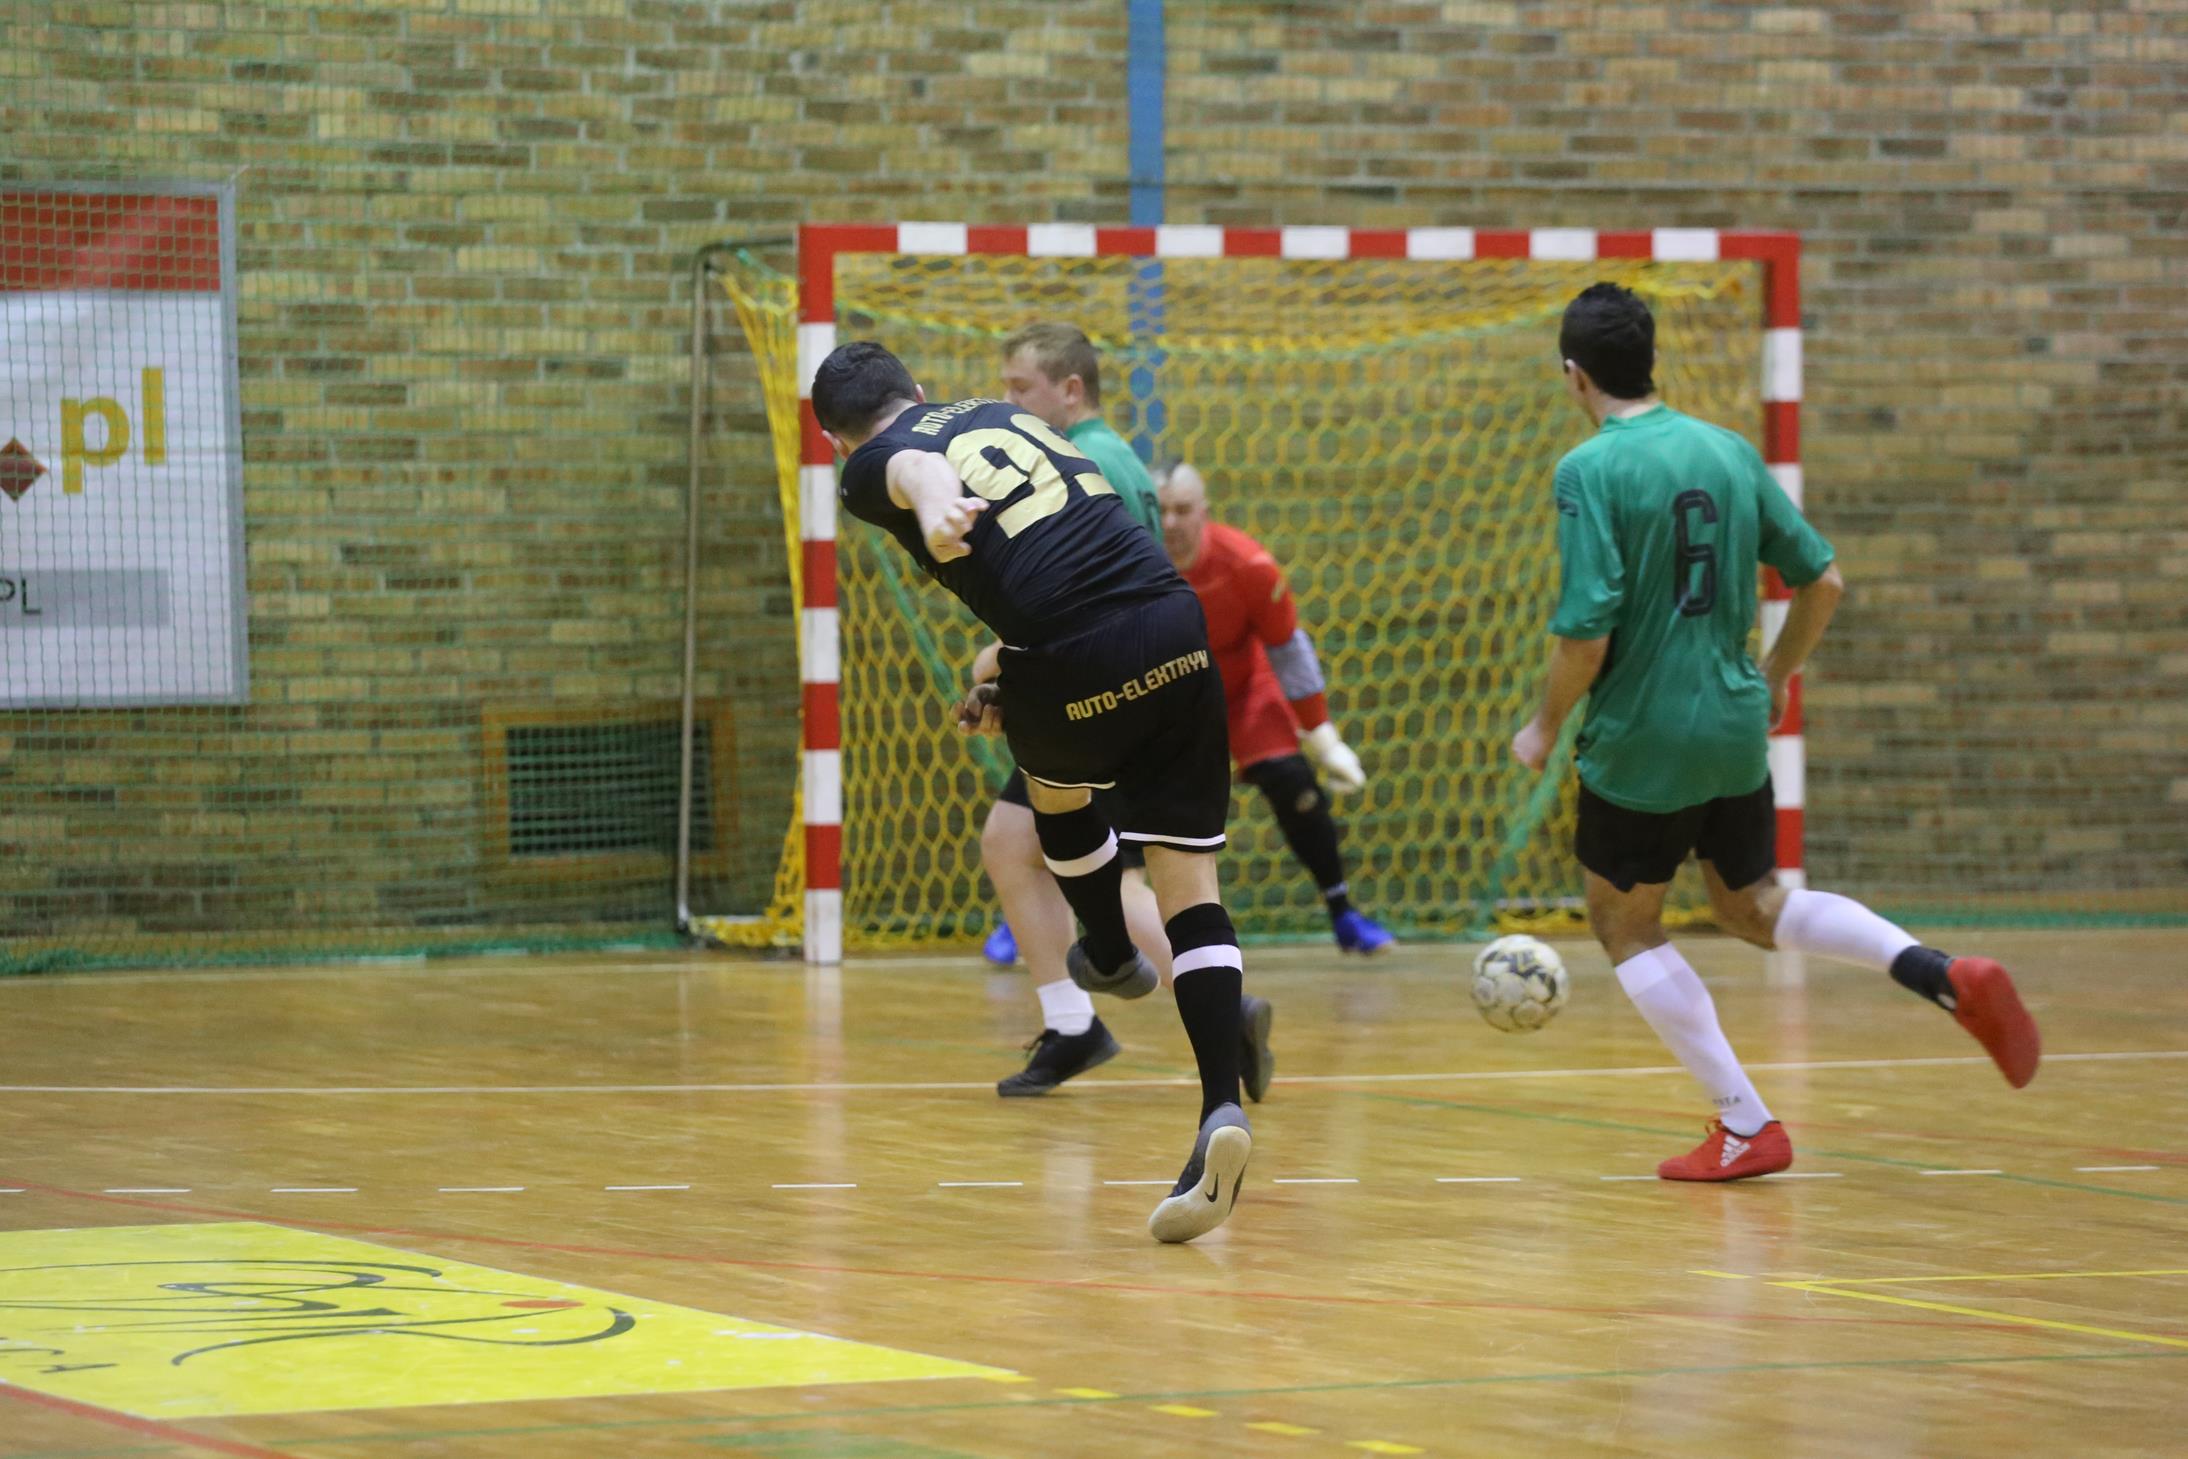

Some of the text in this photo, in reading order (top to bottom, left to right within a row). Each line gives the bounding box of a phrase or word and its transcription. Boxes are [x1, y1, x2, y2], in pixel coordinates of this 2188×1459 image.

[60, 366, 166, 495] pl
[945, 412, 1116, 539] 99
[1673, 488, 1718, 619] 6
